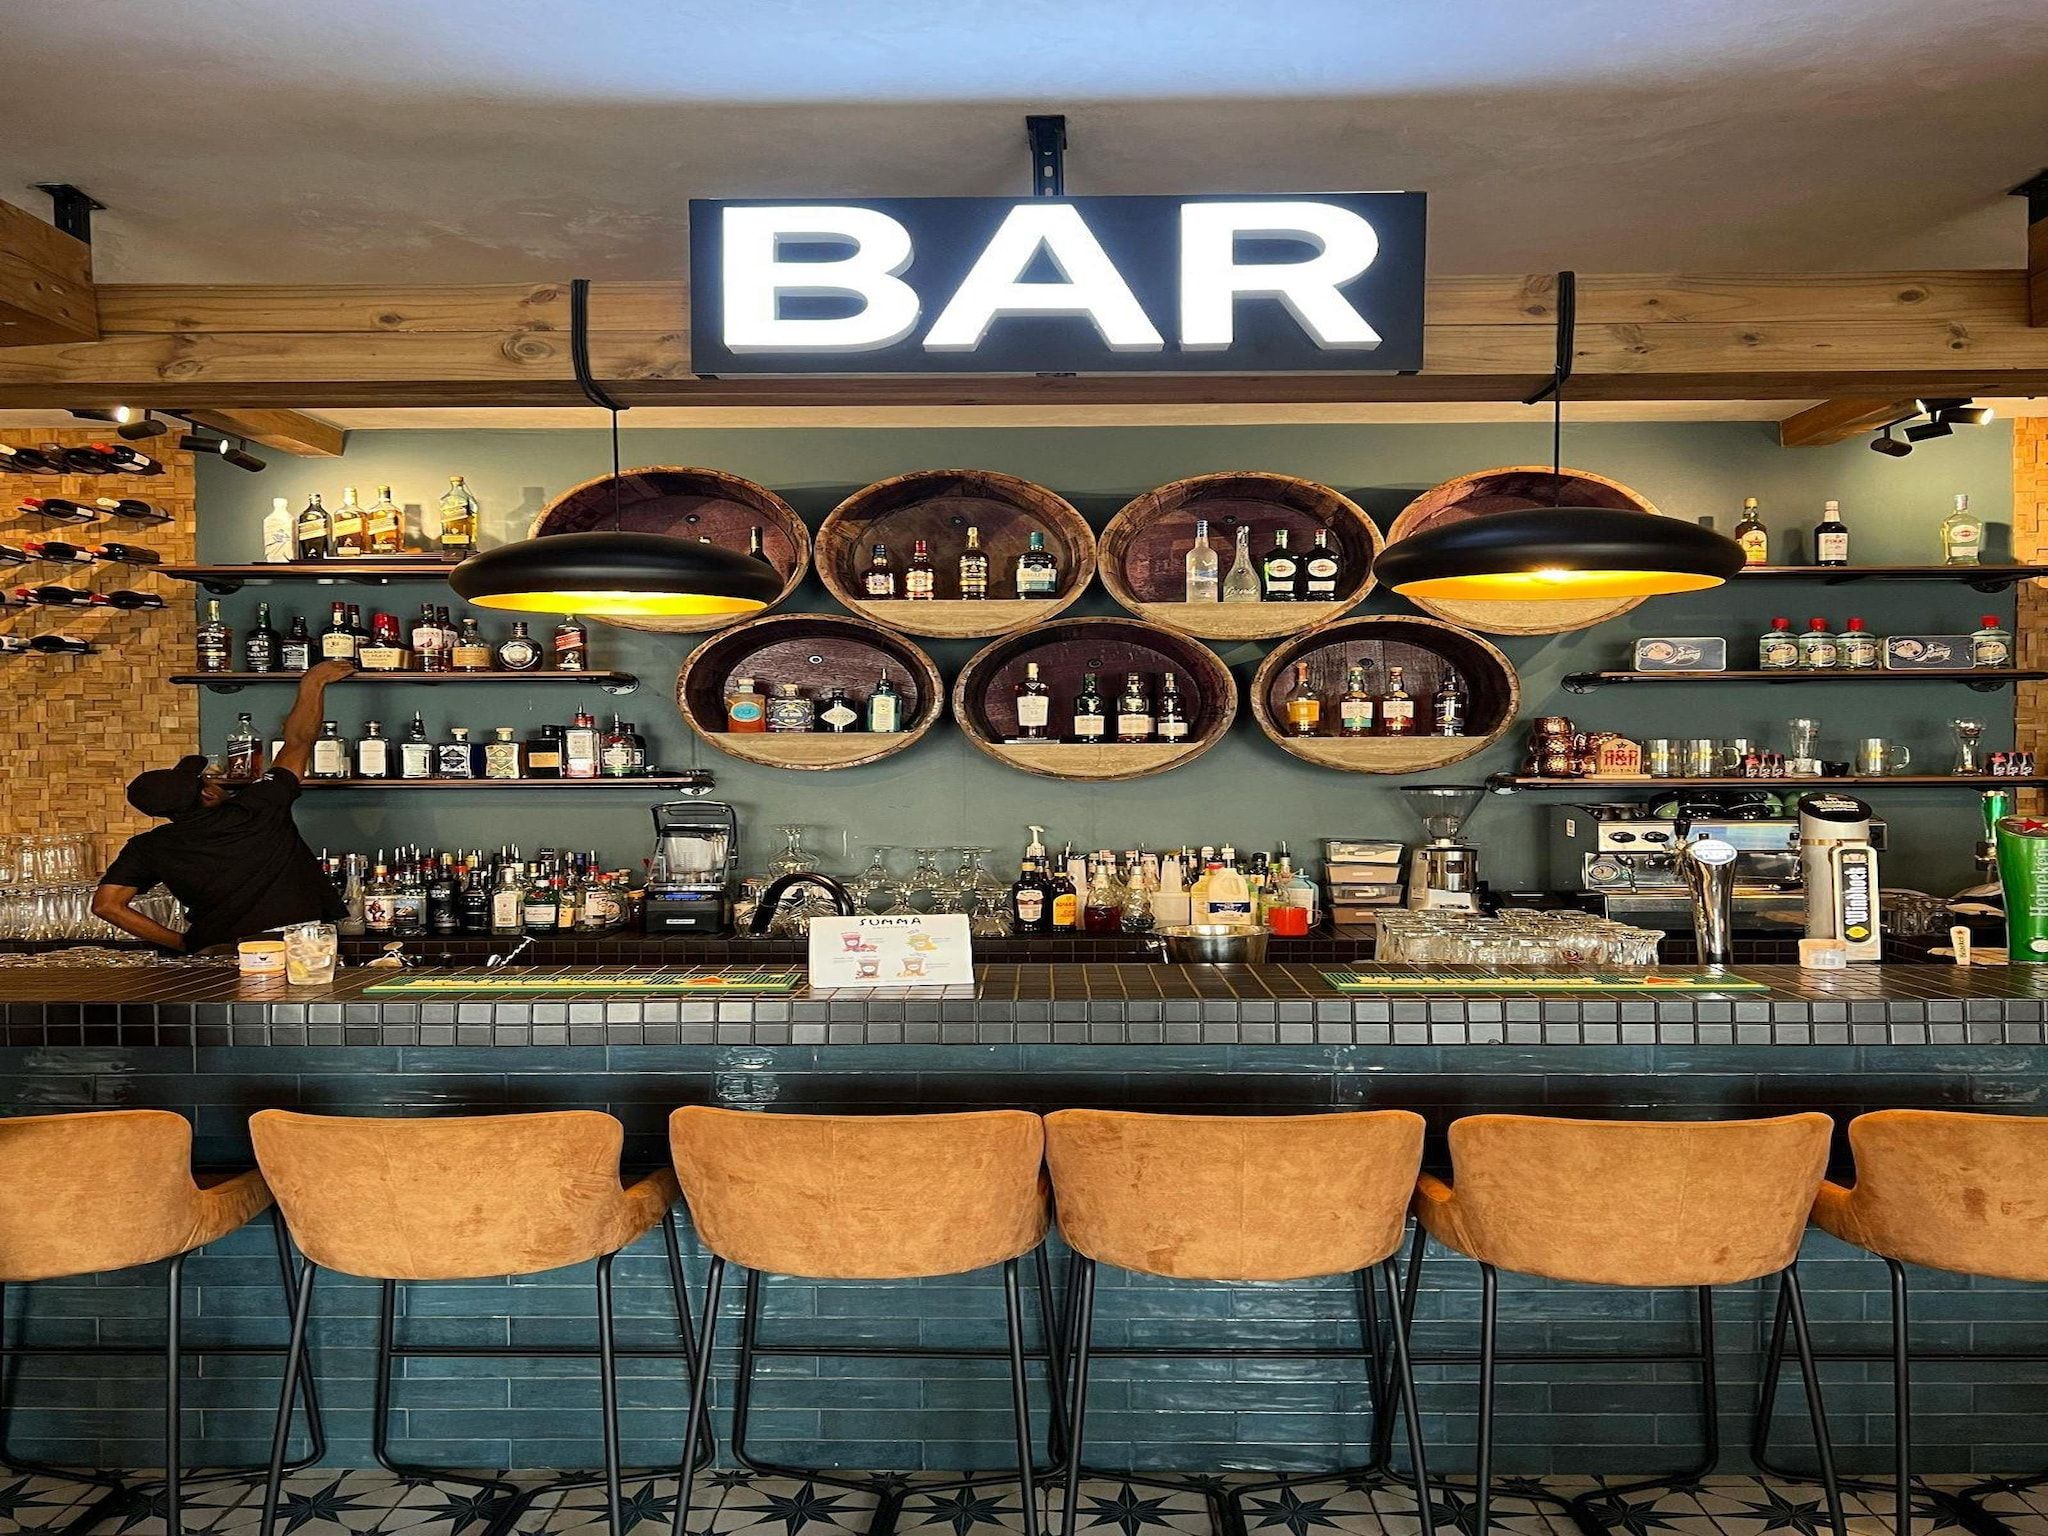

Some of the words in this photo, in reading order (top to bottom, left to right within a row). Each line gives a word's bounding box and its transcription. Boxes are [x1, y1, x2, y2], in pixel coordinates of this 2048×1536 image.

[722, 201, 1383, 353] BAR
[1844, 866, 1868, 926] Windhoek
[2029, 848, 2048, 917] Heineken
[858, 917, 922, 927] SUMMA
